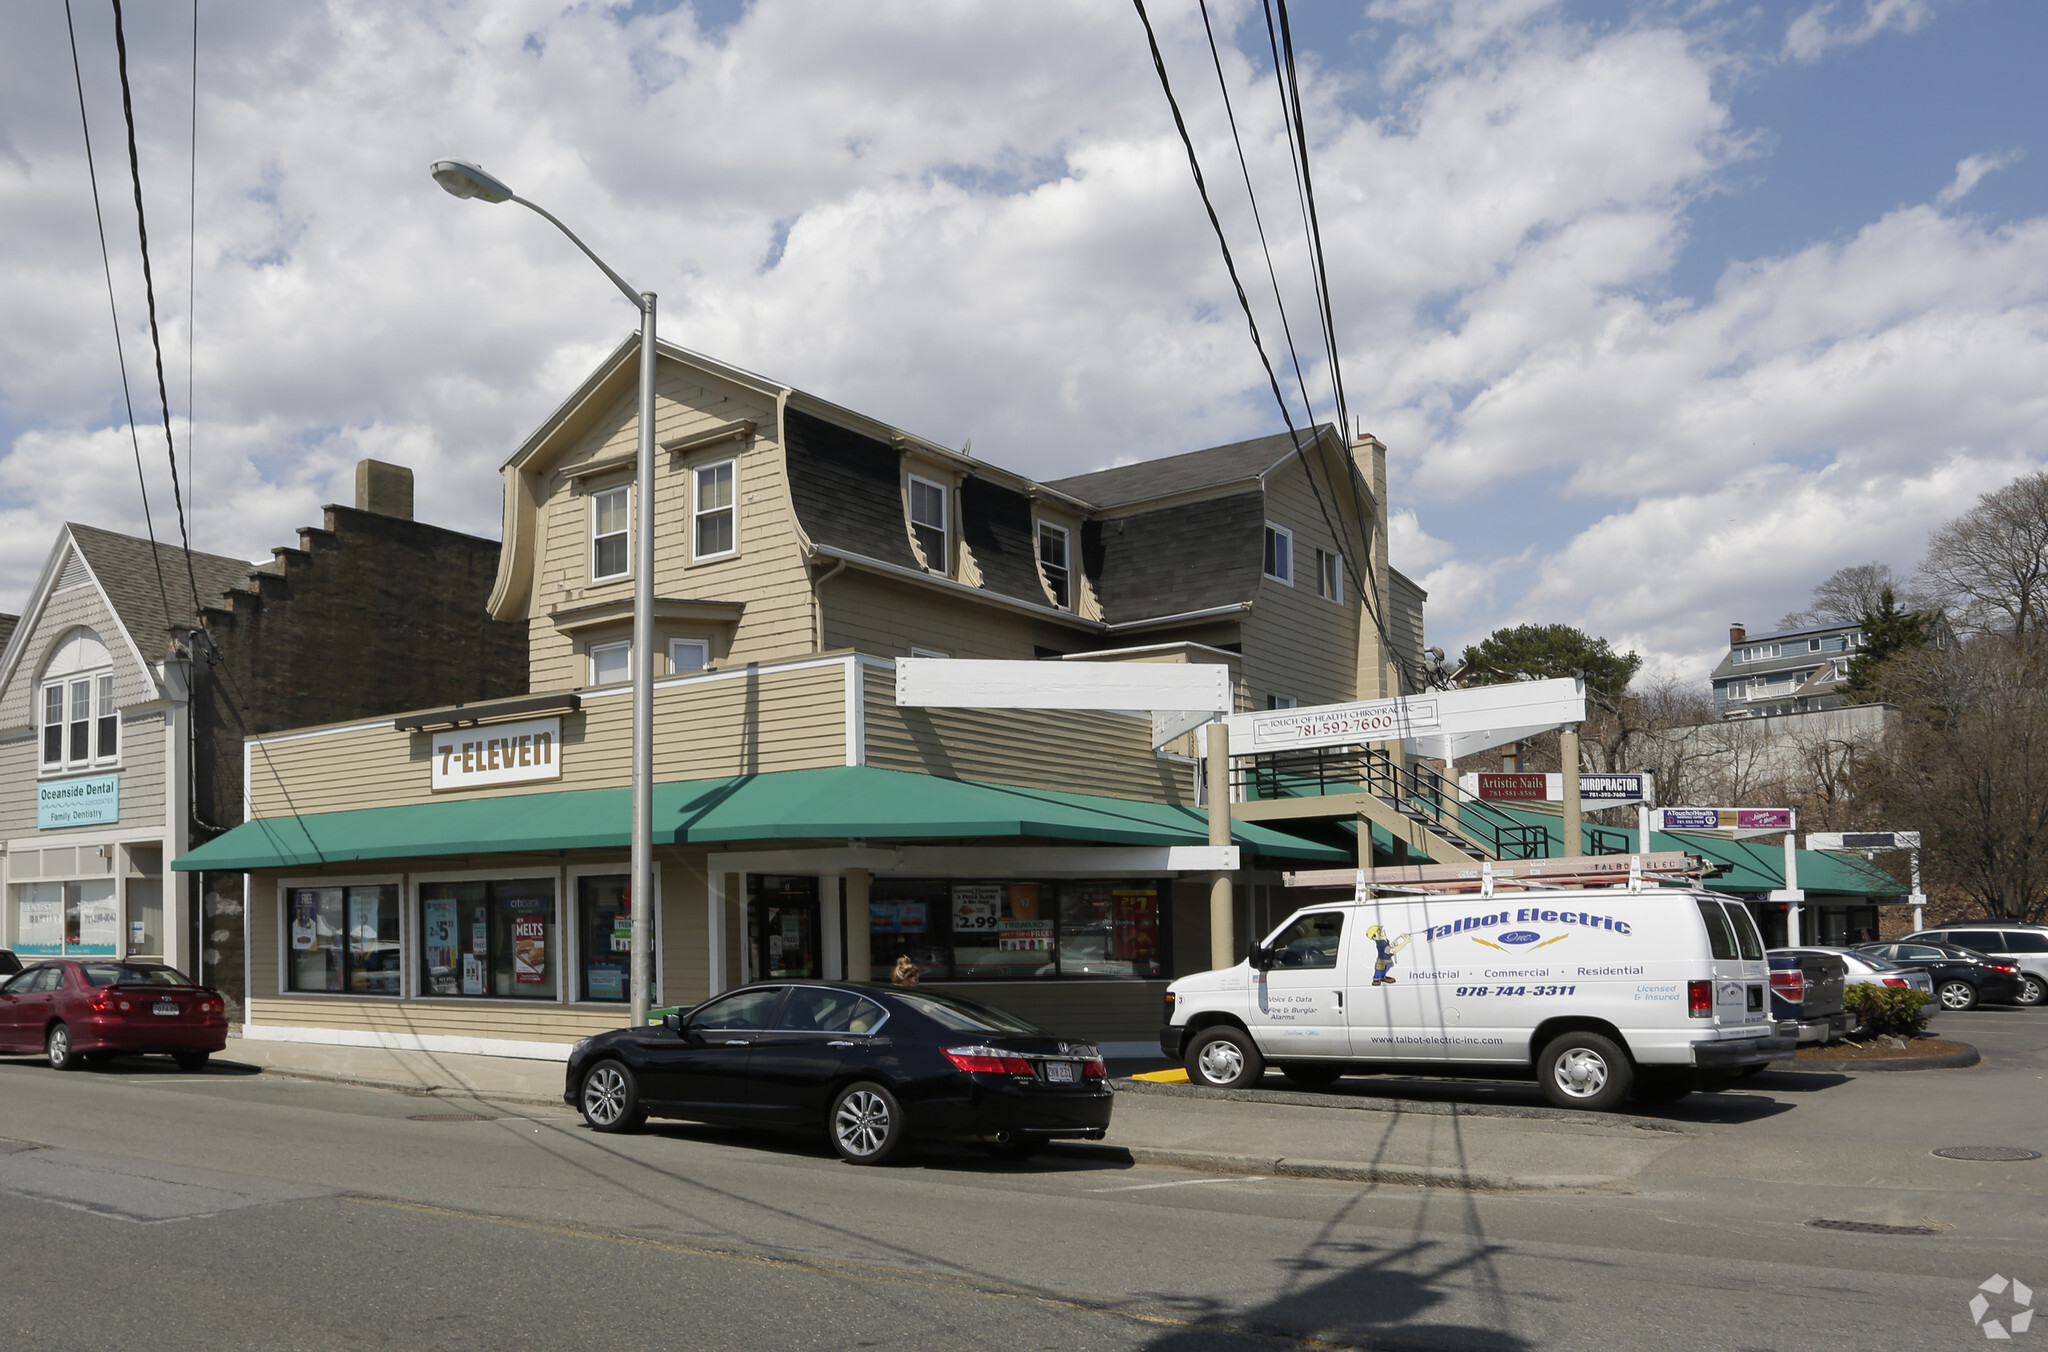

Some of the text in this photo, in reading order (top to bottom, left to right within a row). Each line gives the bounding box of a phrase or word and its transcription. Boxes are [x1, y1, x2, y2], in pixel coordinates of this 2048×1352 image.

[1270, 705, 1415, 728] TOUCH OF HEALTH CHIROPRACTIC
[1296, 716, 1392, 737] 781-592-7600
[1482, 777, 1544, 788] Artistic Nails
[41, 782, 114, 800] Oceanside Dental
[51, 810, 102, 821] Family Dentistry
[1594, 863, 1629, 871] TALBO
[516, 923, 543, 936] MELTS
[1423, 908, 1632, 943] Talbot Electric
[1506, 932, 1533, 942] Inc.
[1409, 966, 1643, 980] Industrial Commercial Residential
[1455, 985, 1576, 997] 978-744-3311
[1371, 1036, 1503, 1045] www.talbot-electric-inc.com
